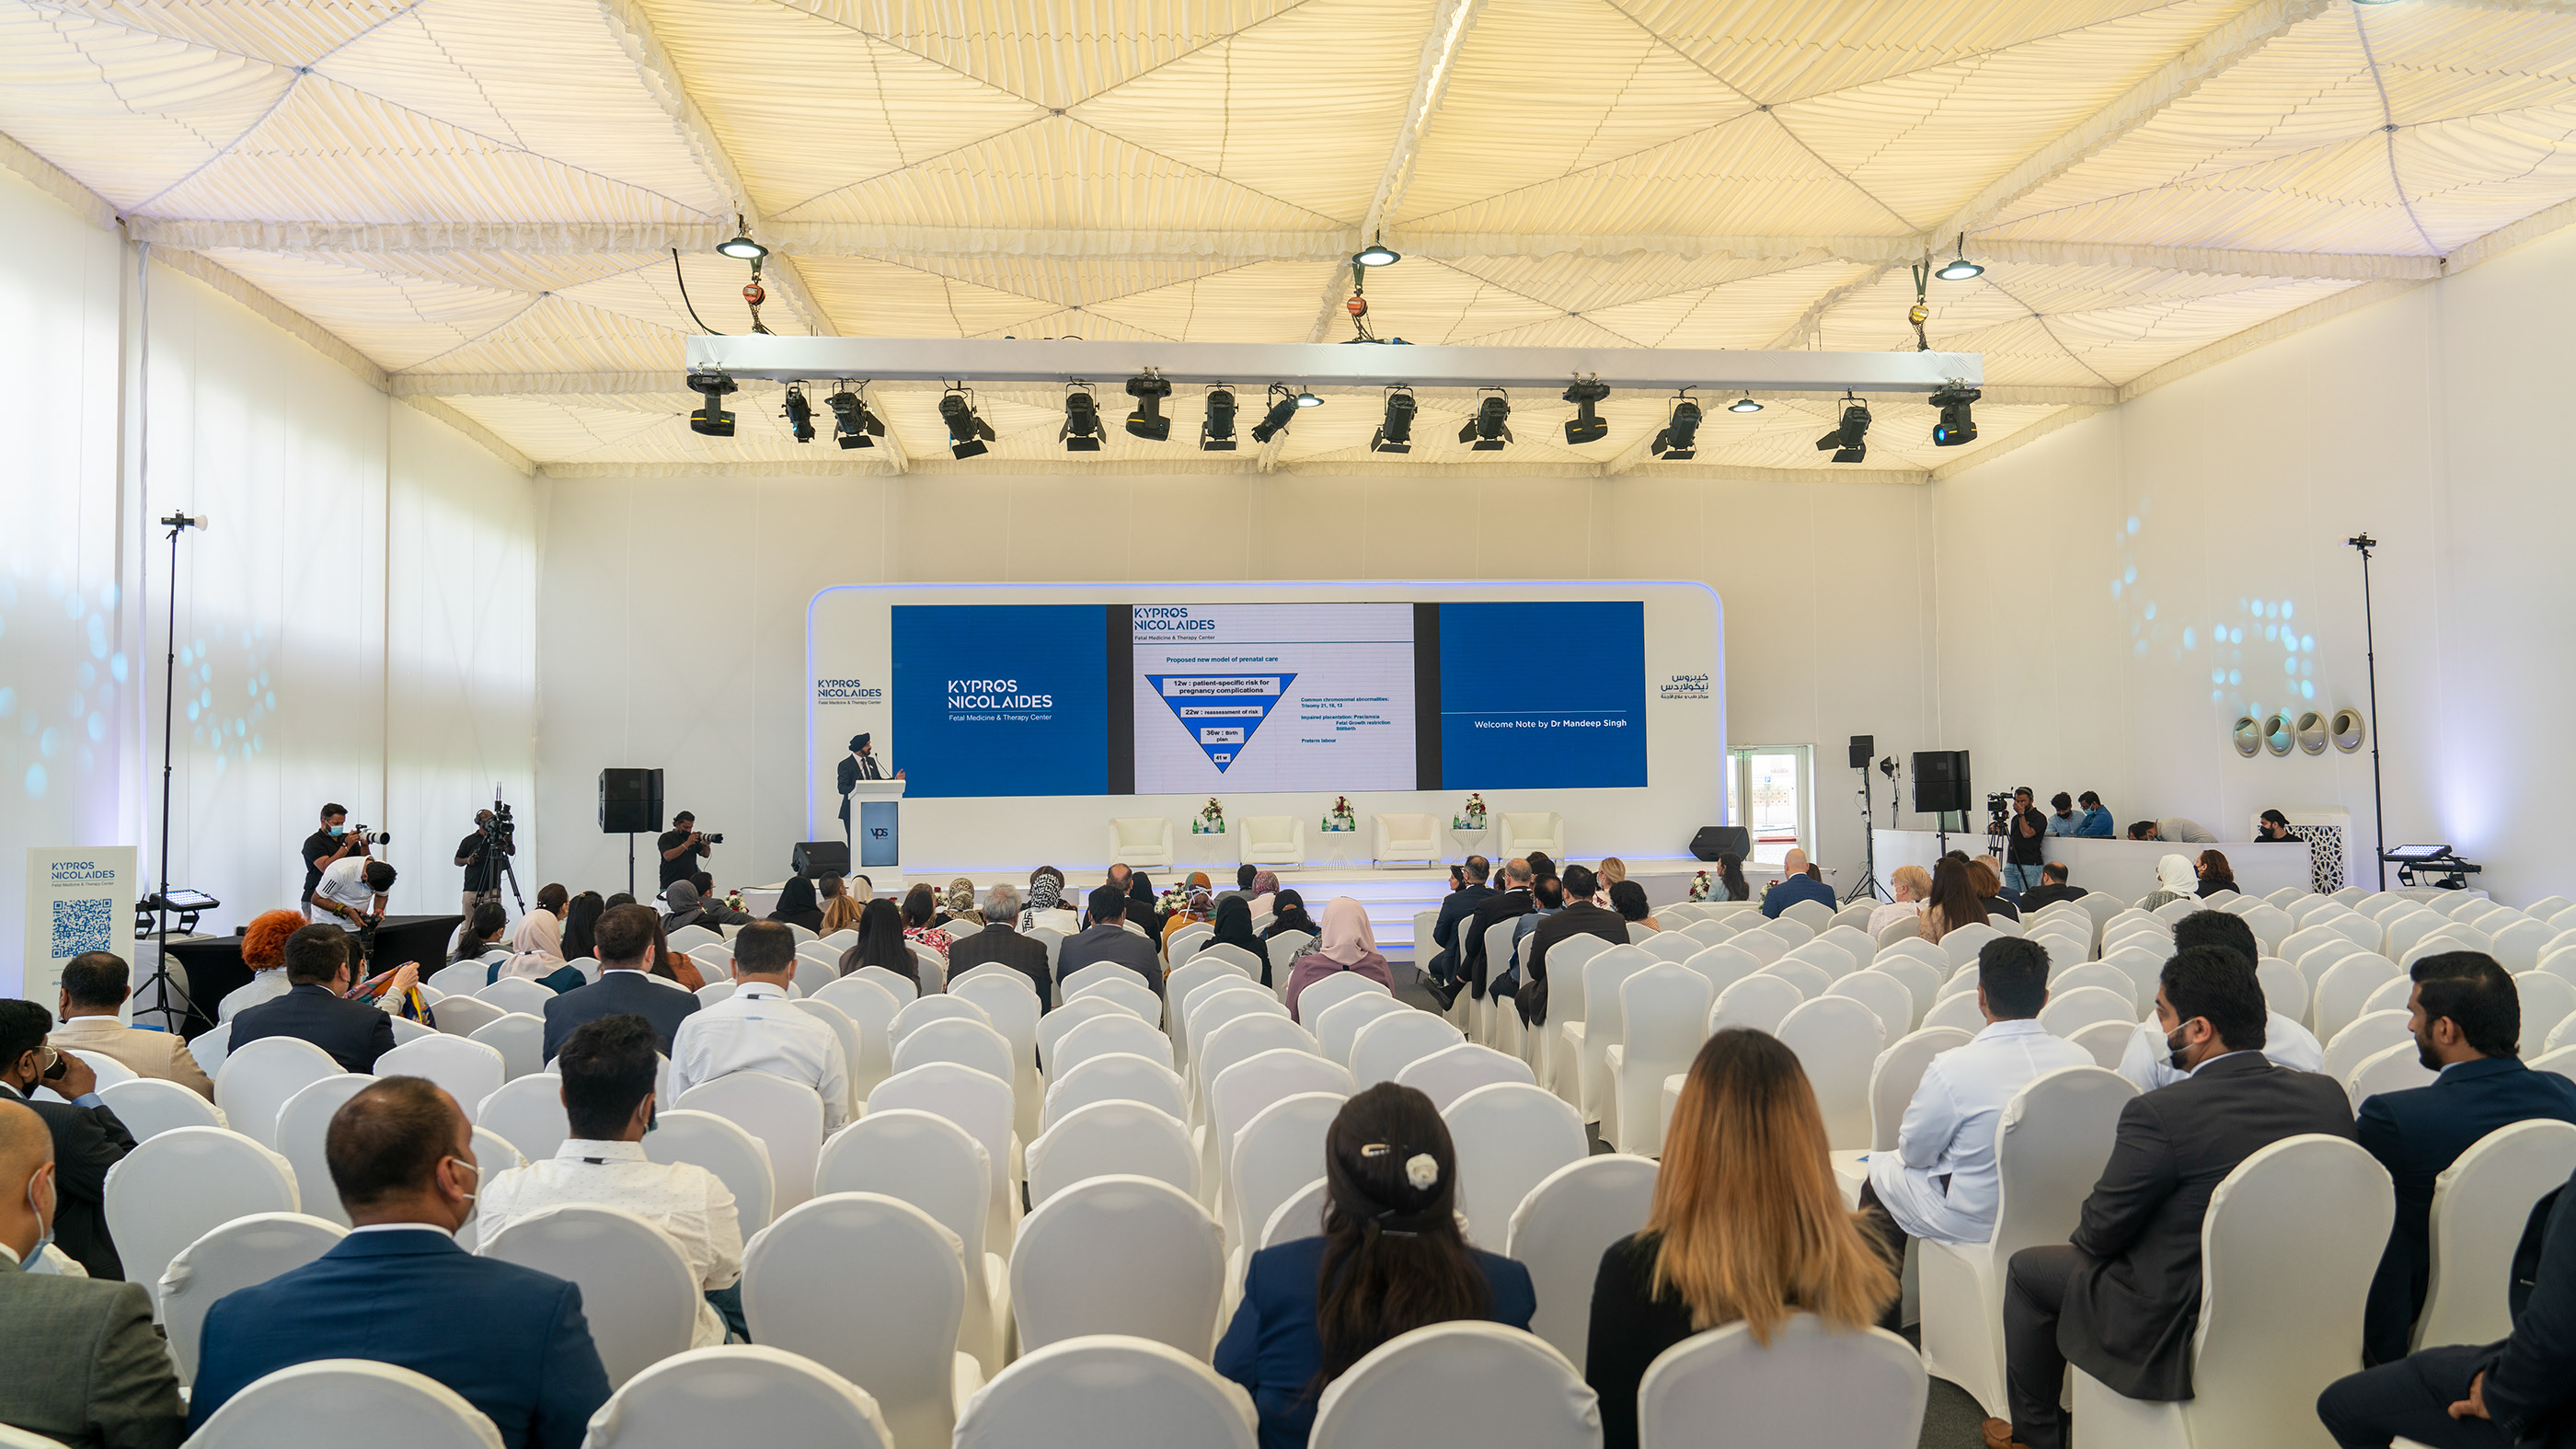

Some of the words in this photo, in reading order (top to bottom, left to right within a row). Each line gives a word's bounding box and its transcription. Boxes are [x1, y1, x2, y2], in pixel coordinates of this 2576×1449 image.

[1134, 607, 1188, 618] KYPROS
[1134, 619, 1214, 630] NICOLAIDES
[949, 679, 1018, 693] KYPROS
[949, 695, 1052, 709] NICOLAIDES
[1003, 714, 1029, 722] Therapy
[1538, 720, 1548, 729] by
[1550, 719, 1561, 728] Dr
[1563, 719, 1601, 729] Mandeep
[1604, 719, 1627, 729] Singh
[52, 861, 95, 870] KYPROS
[52, 870, 115, 880] NICOLAIDES
